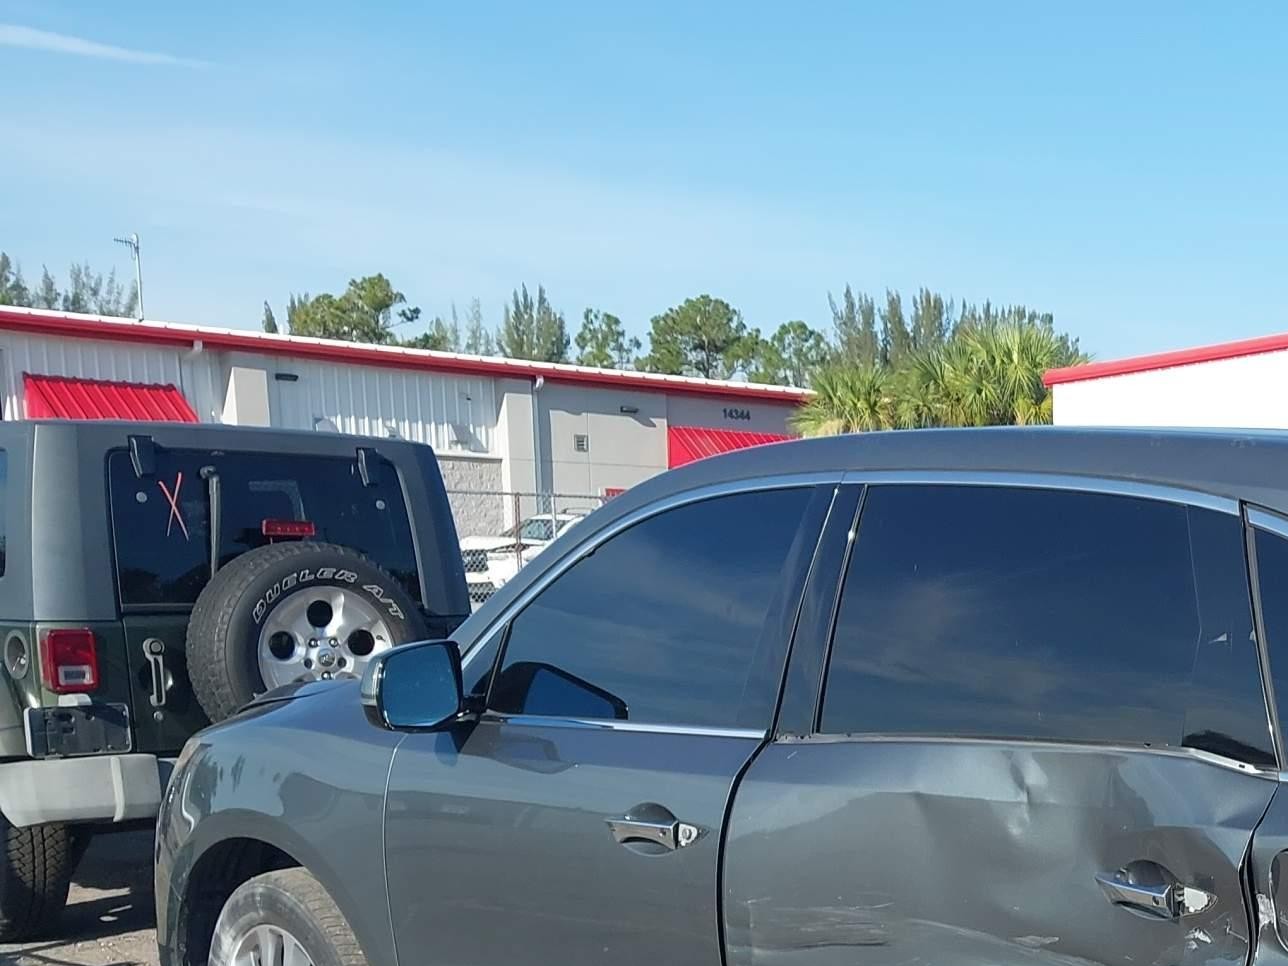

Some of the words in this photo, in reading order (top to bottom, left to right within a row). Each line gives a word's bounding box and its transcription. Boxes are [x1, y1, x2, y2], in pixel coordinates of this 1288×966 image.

[722, 407, 751, 421] 14344
[251, 567, 359, 625] DUELER
[362, 584, 406, 621] A/T
